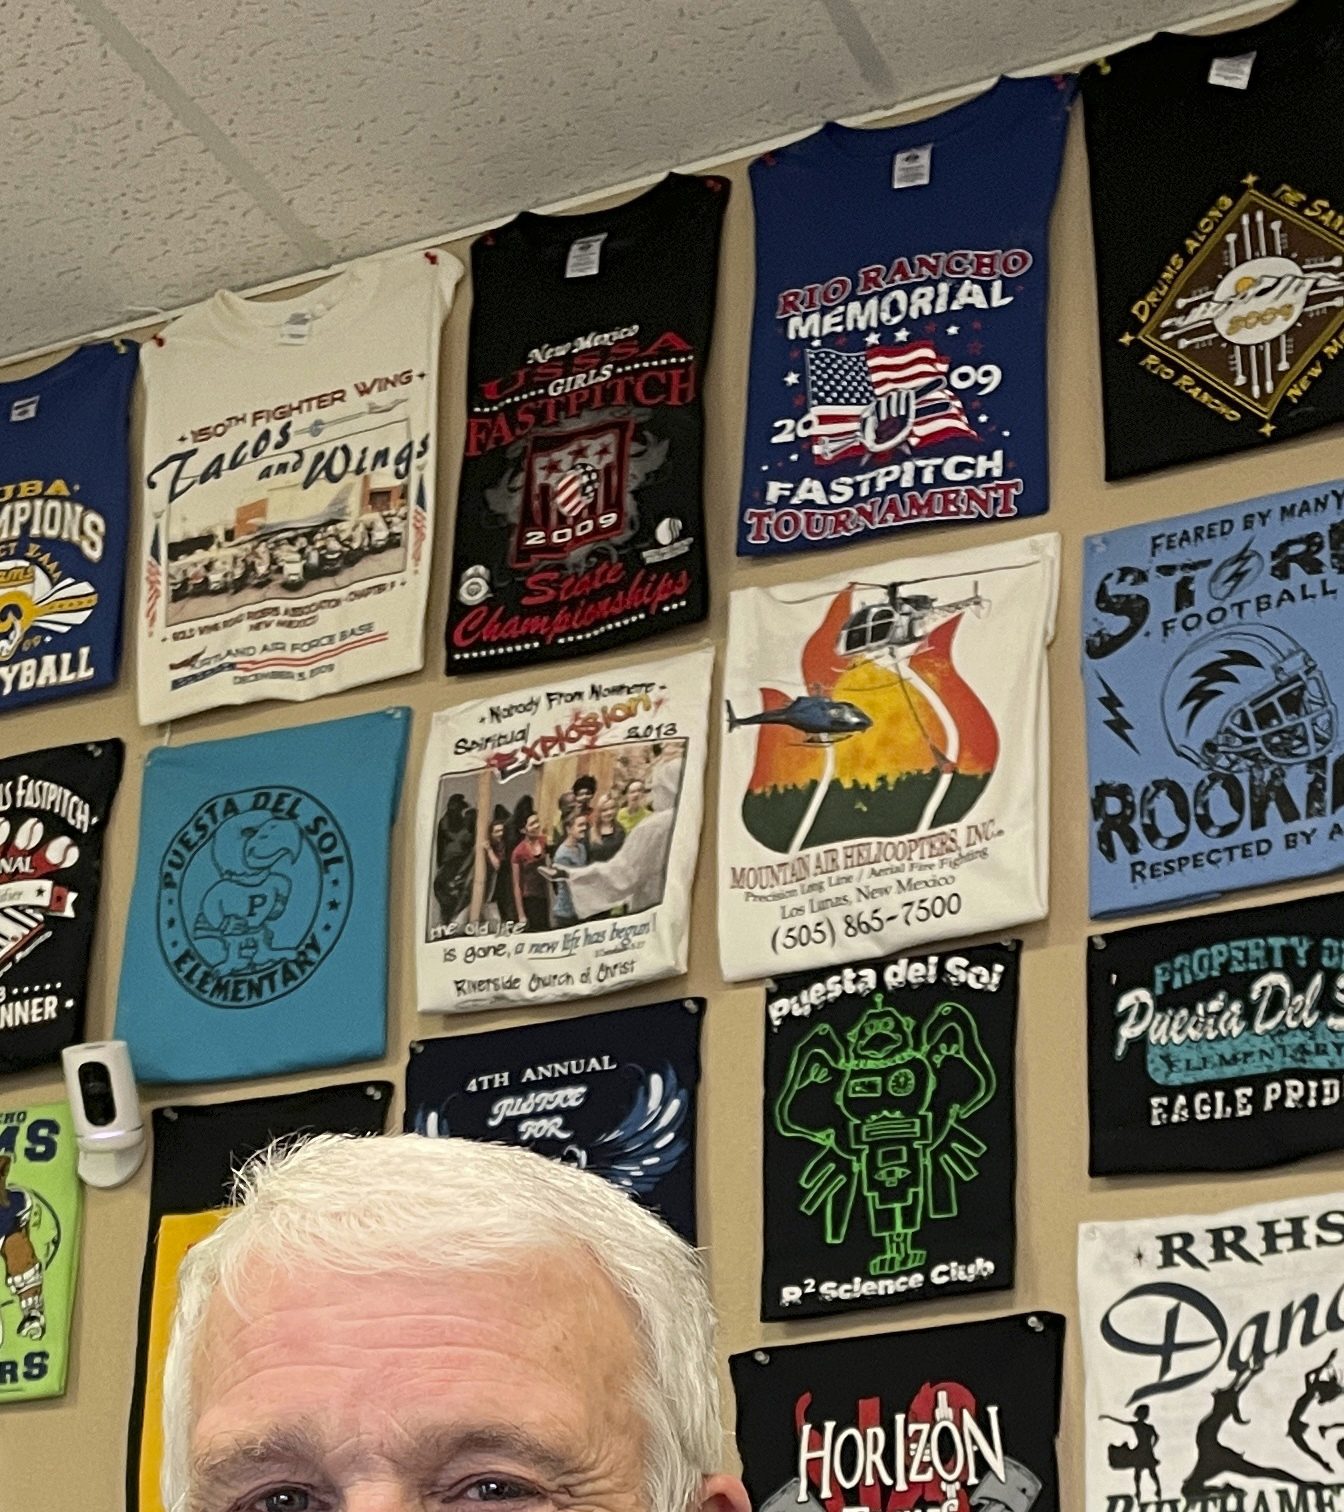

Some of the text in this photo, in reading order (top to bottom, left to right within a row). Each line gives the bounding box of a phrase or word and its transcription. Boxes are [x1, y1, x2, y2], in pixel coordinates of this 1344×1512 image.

[776, 247, 1034, 320] RIO RANCHO
[786, 278, 1015, 341] MEMORIAL
[250, 368, 416, 428] FIGHTER WING
[464, 359, 697, 457] FASTPITCH
[547, 363, 615, 397] GIRLS
[146, 420, 293, 505] Tacos
[301, 432, 432, 491] Wings
[764, 449, 1005, 507] FASTPITCH
[523, 511, 619, 546] 2009
[743, 478, 1024, 546] TOURNAMENT
[1149, 517, 1236, 558] FEARED
[1241, 507, 1273, 532] BY
[14, 774, 92, 835] FASTPITCH
[160, 791, 345, 891] PUESTA DEL SOL
[1129, 828, 1318, 886] RESPECTED BY
[770, 891, 963, 956] (505) 865-7500
[171, 930, 324, 1003] ELEMENTARY
[1153, 936, 1316, 997] PROPERTY
[767, 965, 879, 1033] Puesta
[1248, 970, 1327, 1037] Del
[464, 1054, 618, 1093] 4TH ANNUAL
[1149, 1085, 1255, 1127] EAGLE
[817, 1270, 925, 1302] Science
[795, 1404, 1008, 1503] HORIZON
